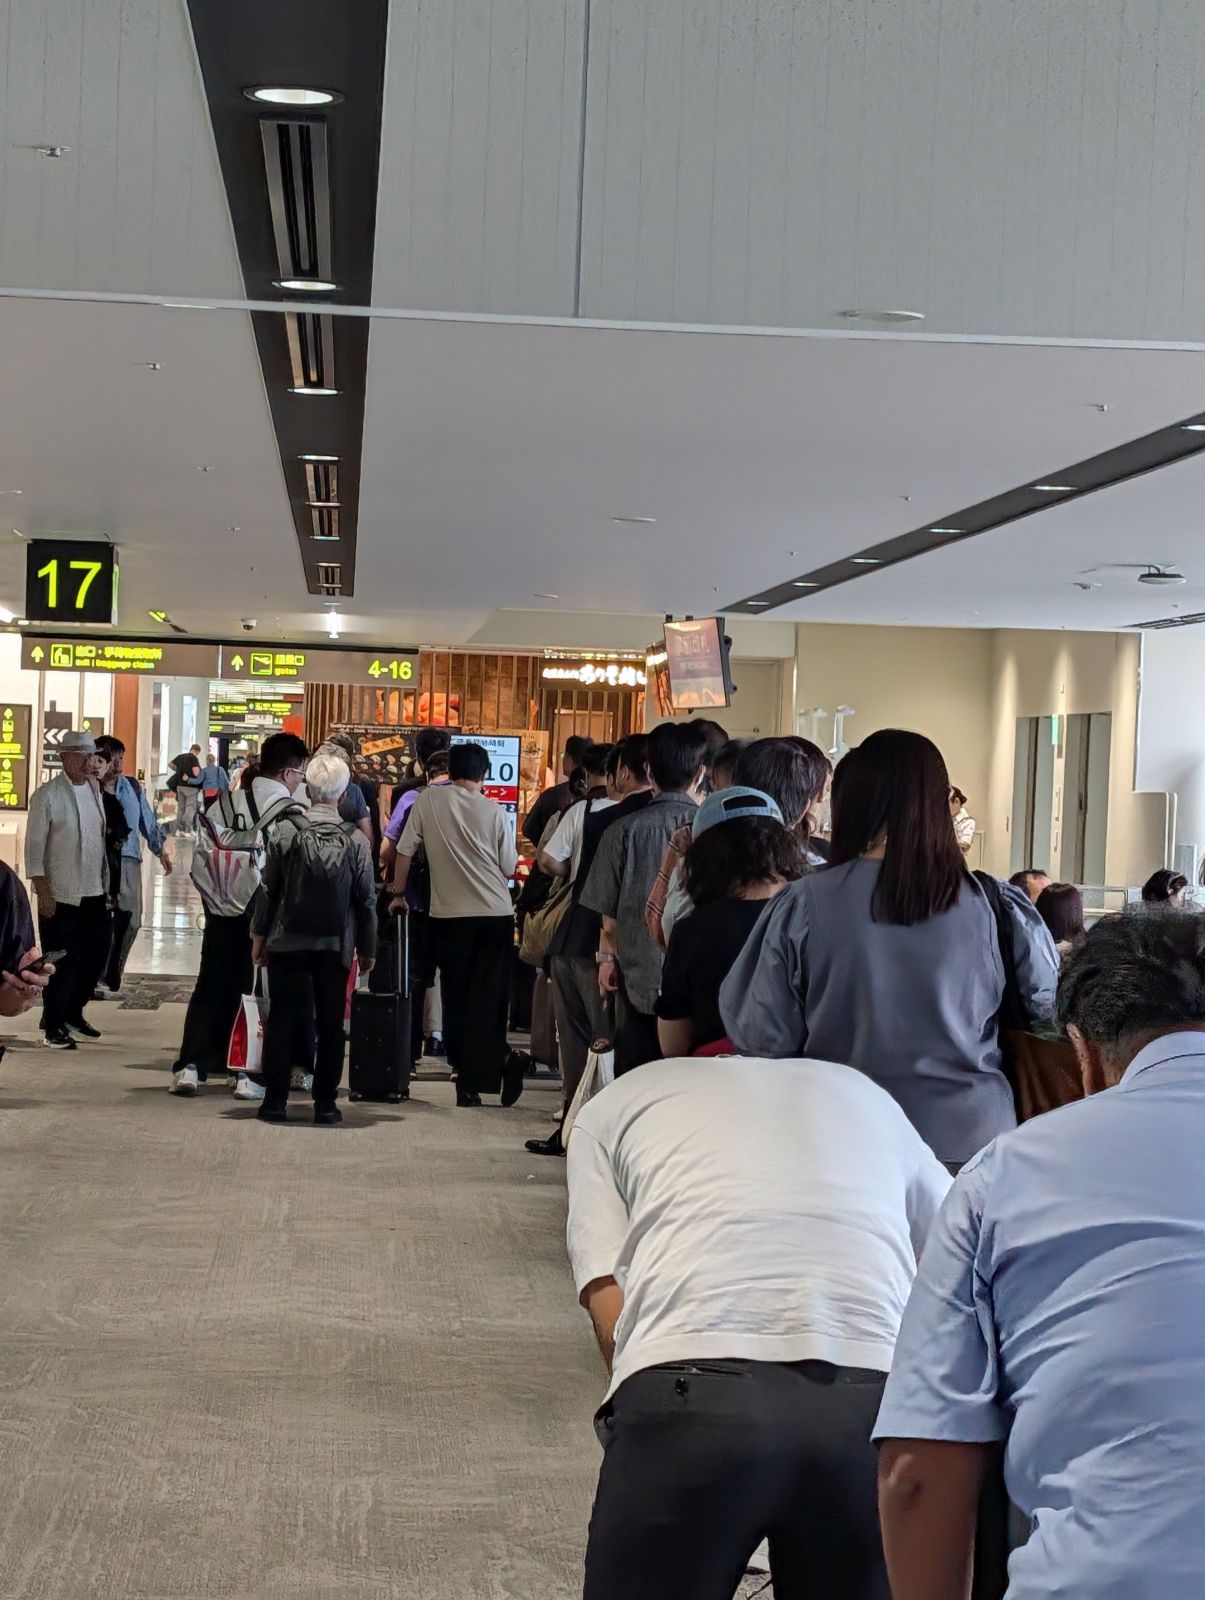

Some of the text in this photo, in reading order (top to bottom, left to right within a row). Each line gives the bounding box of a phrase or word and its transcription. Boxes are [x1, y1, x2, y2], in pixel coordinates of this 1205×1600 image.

[38, 559, 102, 609] 17
[274, 667, 298, 676] gates
[367, 660, 412, 680] 4-16
